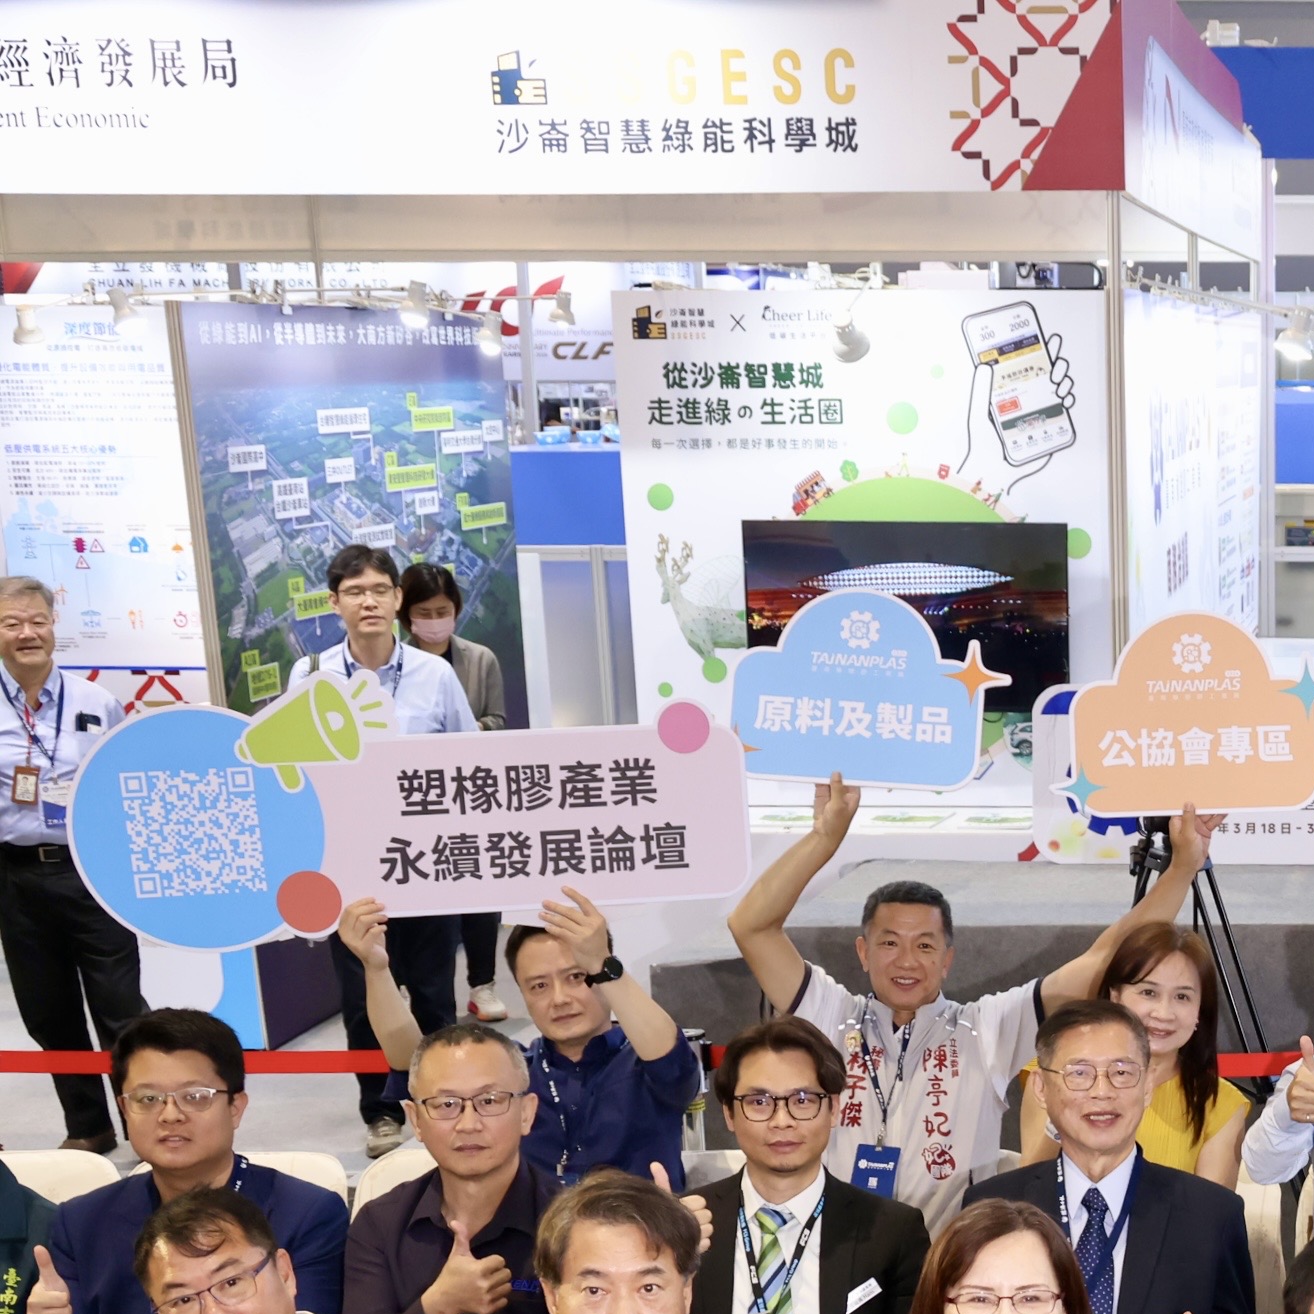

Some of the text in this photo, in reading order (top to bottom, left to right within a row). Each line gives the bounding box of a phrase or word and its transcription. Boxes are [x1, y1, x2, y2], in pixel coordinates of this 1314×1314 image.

[0, 35, 238, 90] 經濟發展局
[35, 106, 150, 129] Economic
[497, 117, 859, 154] 沙崙智慧綠能科學城
[169, 277, 185, 288] FA
[662, 361, 824, 389] 從沙崙智慧城
[647, 396, 844, 426] 走進綠の生活圈
[753, 694, 953, 745] 原料及製品
[1097, 724, 1293, 769] 公協會專區
[396, 757, 658, 817] 塑橡膠產業
[379, 822, 690, 886] 永續發展論壇
[923, 1044, 951, 1138] 陳亭妃
